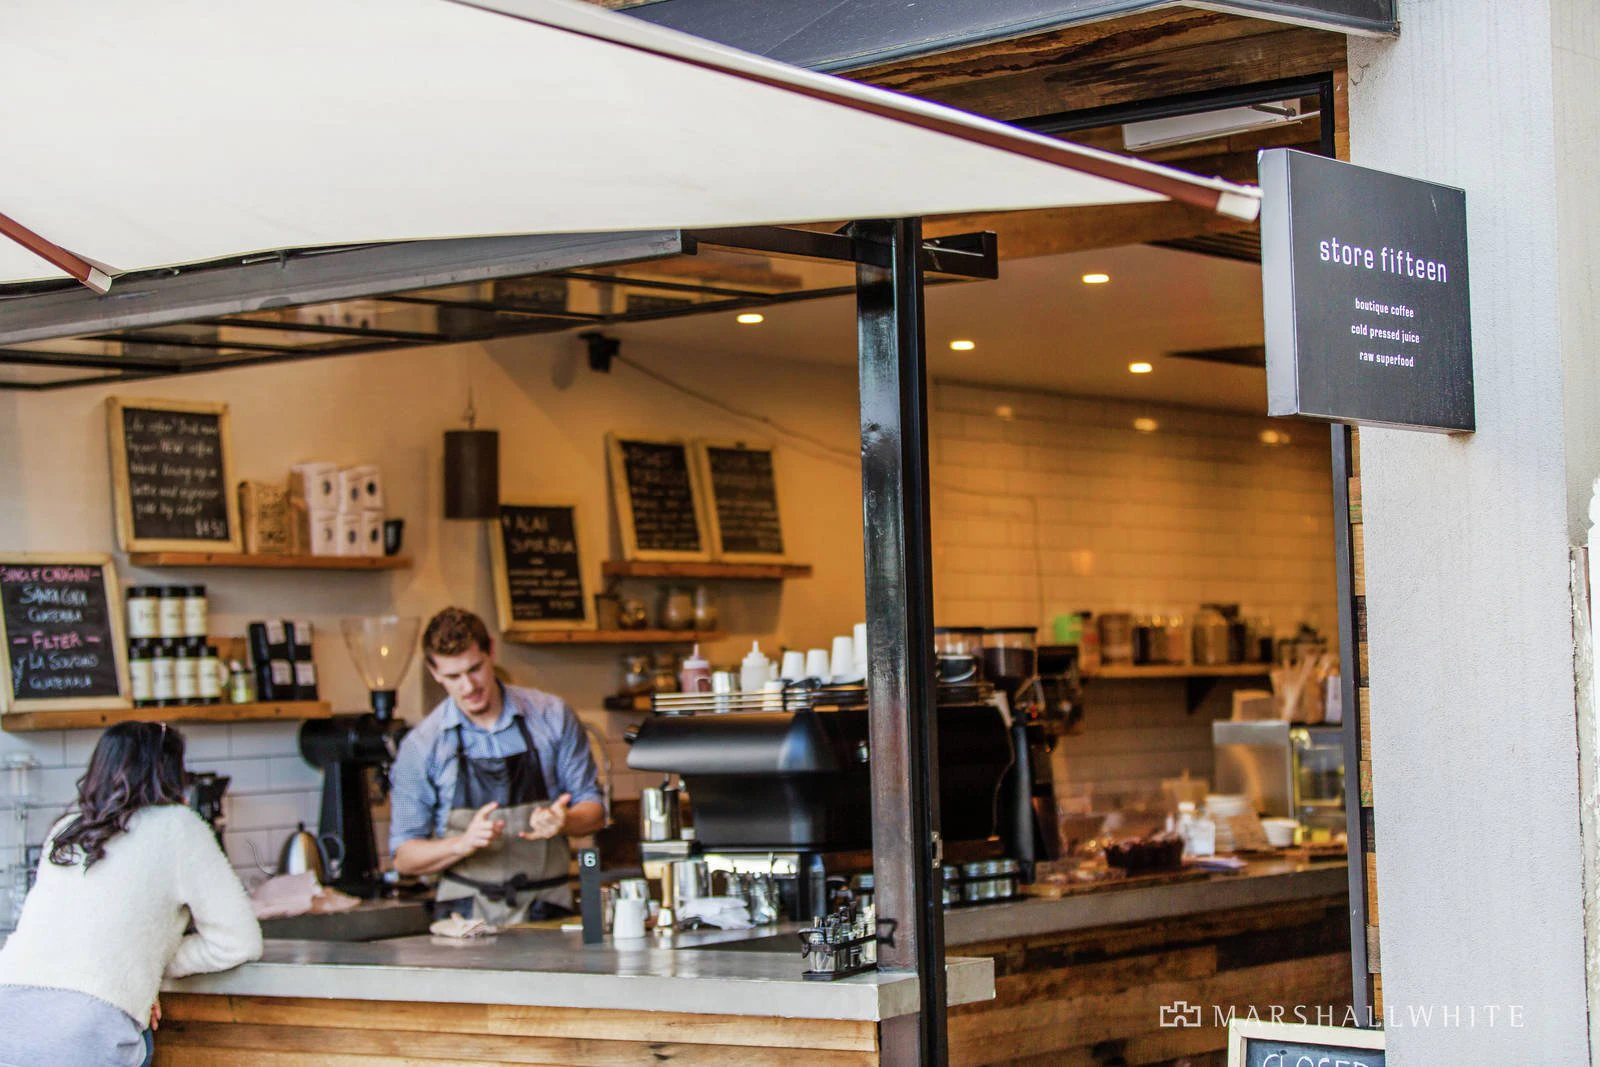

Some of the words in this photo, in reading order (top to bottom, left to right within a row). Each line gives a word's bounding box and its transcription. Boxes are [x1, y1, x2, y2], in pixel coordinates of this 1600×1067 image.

[1320, 237, 1374, 270] store
[1380, 246, 1448, 283] fifteen
[1355, 297, 1389, 315] boutique
[1390, 303, 1414, 318] coffee
[1351, 324, 1368, 336] cold
[1369, 327, 1400, 341] pressed
[1401, 330, 1420, 344] juice
[1359, 351, 1374, 362] raw
[1376, 352, 1414, 368] superfood
[583, 851, 597, 868] 6
